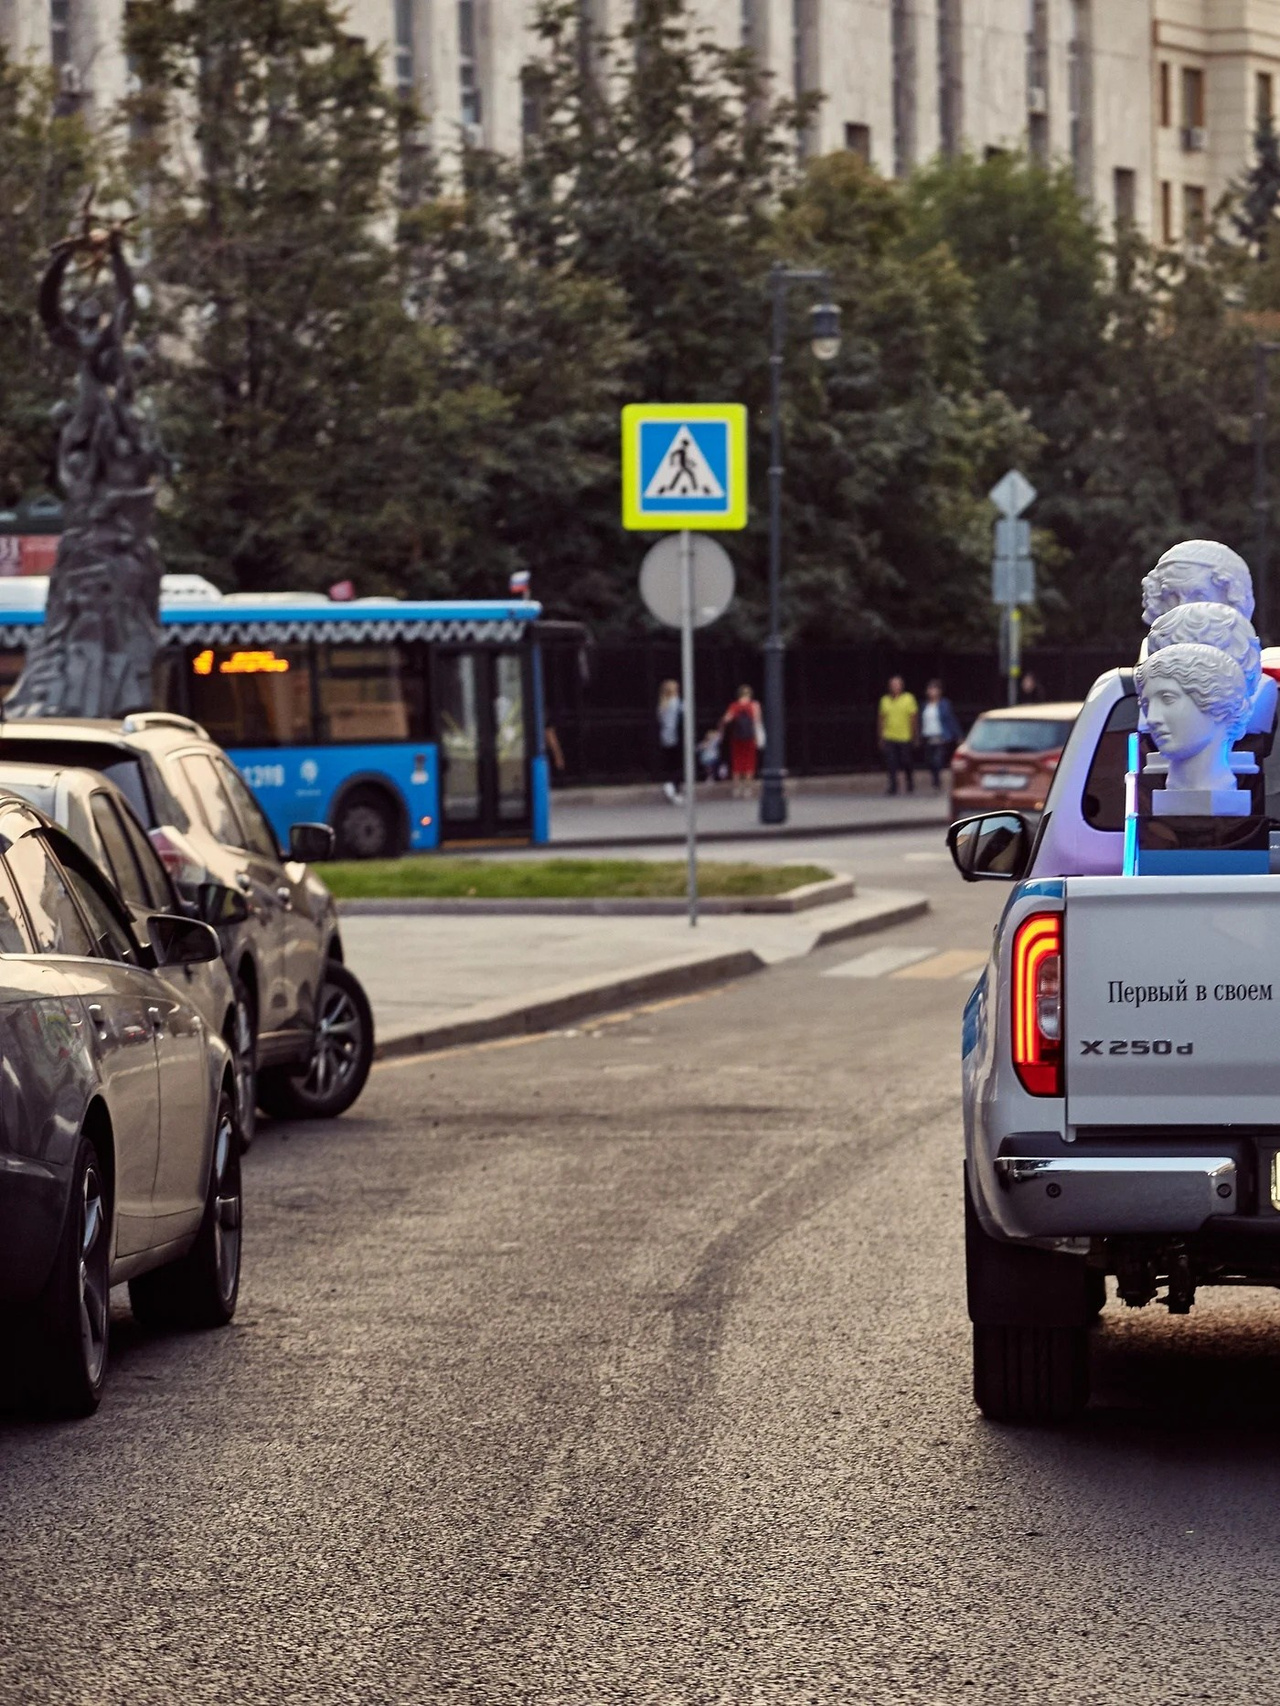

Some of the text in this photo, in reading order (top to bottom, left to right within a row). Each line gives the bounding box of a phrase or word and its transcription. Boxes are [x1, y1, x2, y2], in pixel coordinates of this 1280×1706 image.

[1108, 979, 1188, 1009] Первый
[1195, 984, 1208, 1002] в
[1213, 983, 1273, 1001] своем
